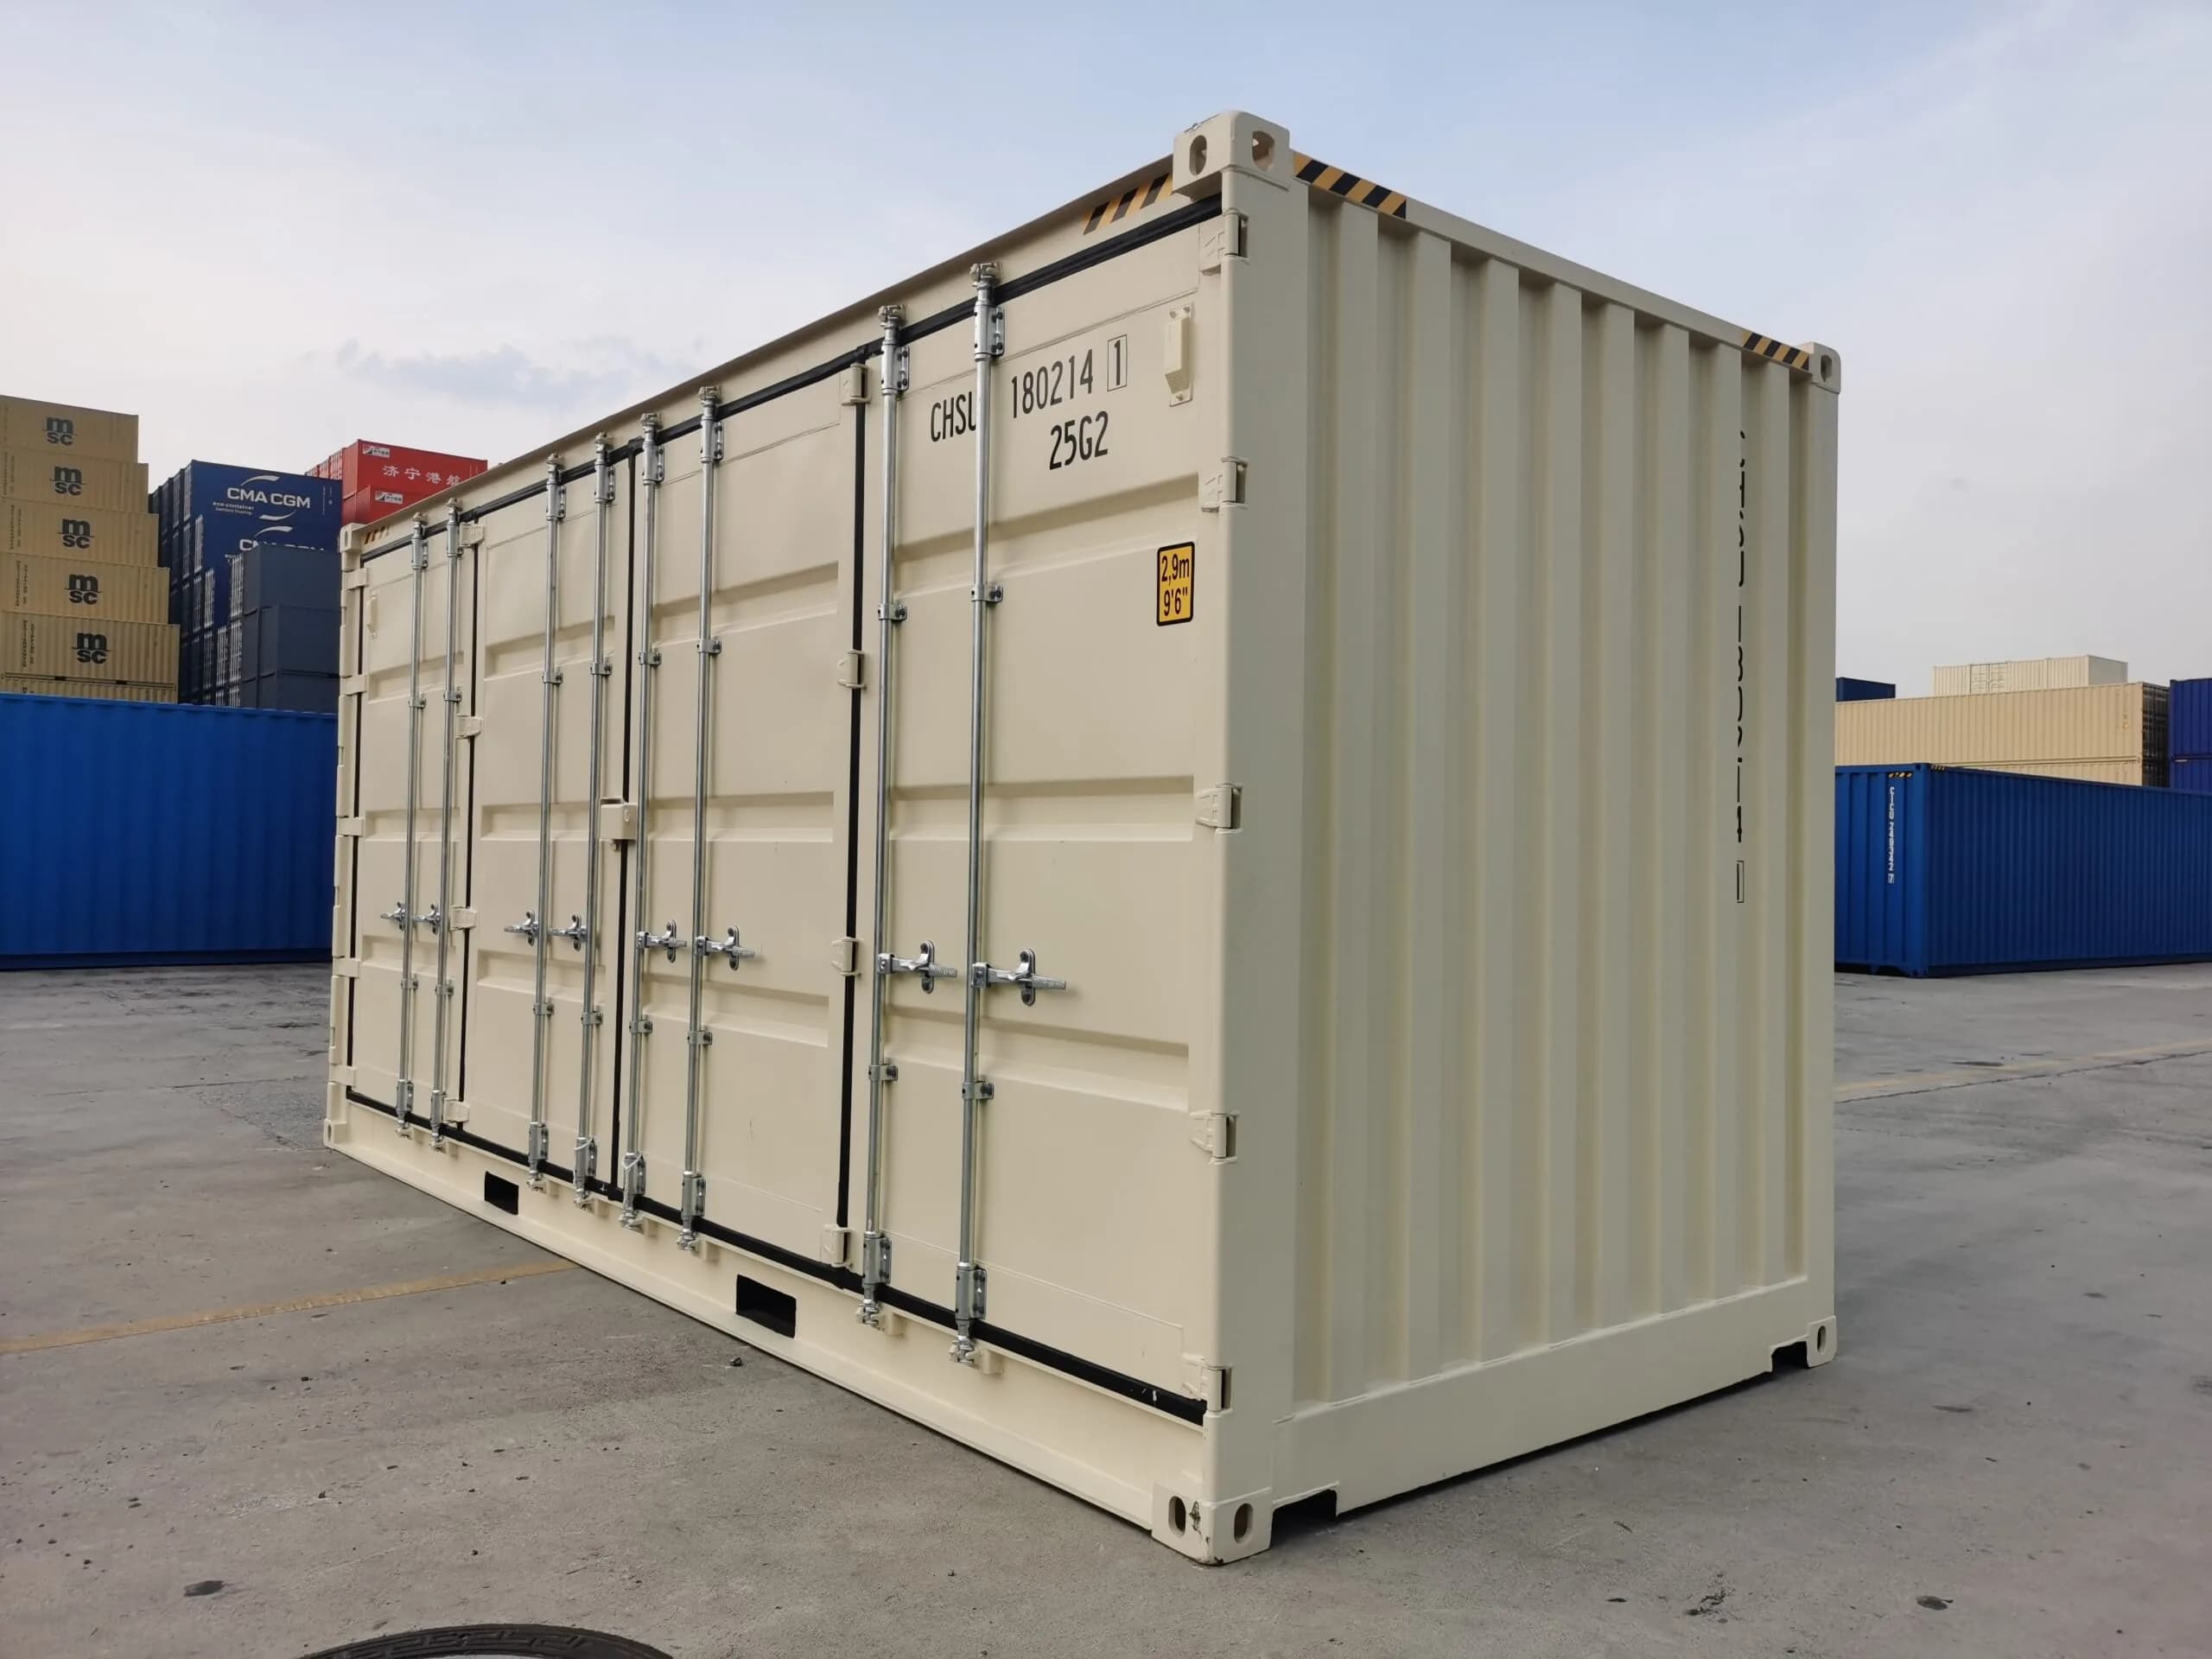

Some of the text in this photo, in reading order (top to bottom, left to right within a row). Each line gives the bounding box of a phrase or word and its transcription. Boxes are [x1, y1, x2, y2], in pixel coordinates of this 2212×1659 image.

[1011, 348, 1094, 419] 180214
[1048, 410, 1109, 470] 25G2
[226, 487, 268, 504] CMA
[270, 493, 311, 509] CGM
[1163, 587, 1189, 617] 9'6"
